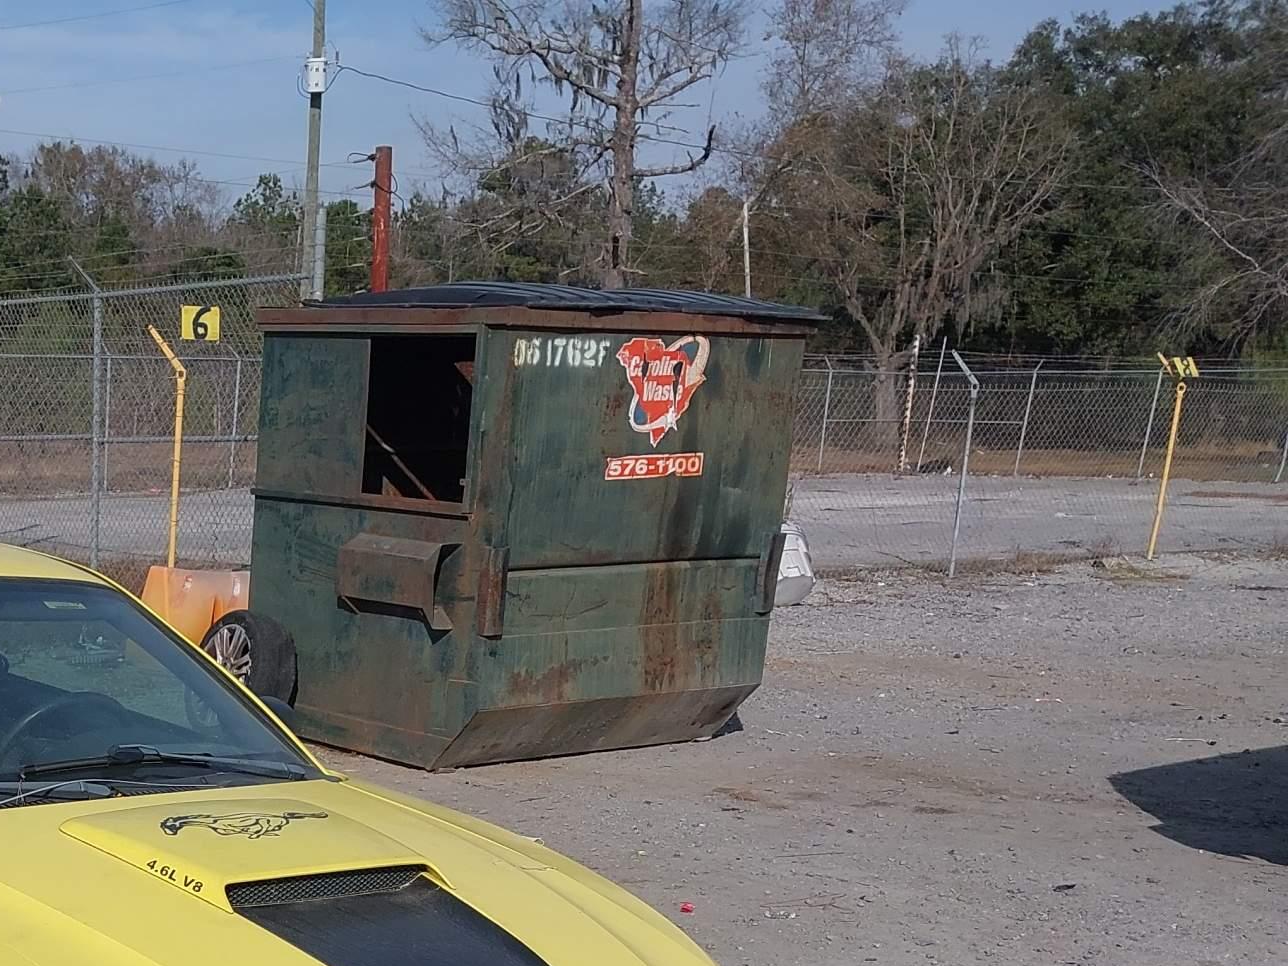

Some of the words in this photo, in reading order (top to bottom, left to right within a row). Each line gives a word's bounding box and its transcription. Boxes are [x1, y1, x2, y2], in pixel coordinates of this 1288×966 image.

[193, 304, 211, 340] 6
[609, 457, 700, 476] 576-1100
[146, 860, 177, 882] 4.6L
[184, 875, 203, 893] V8
